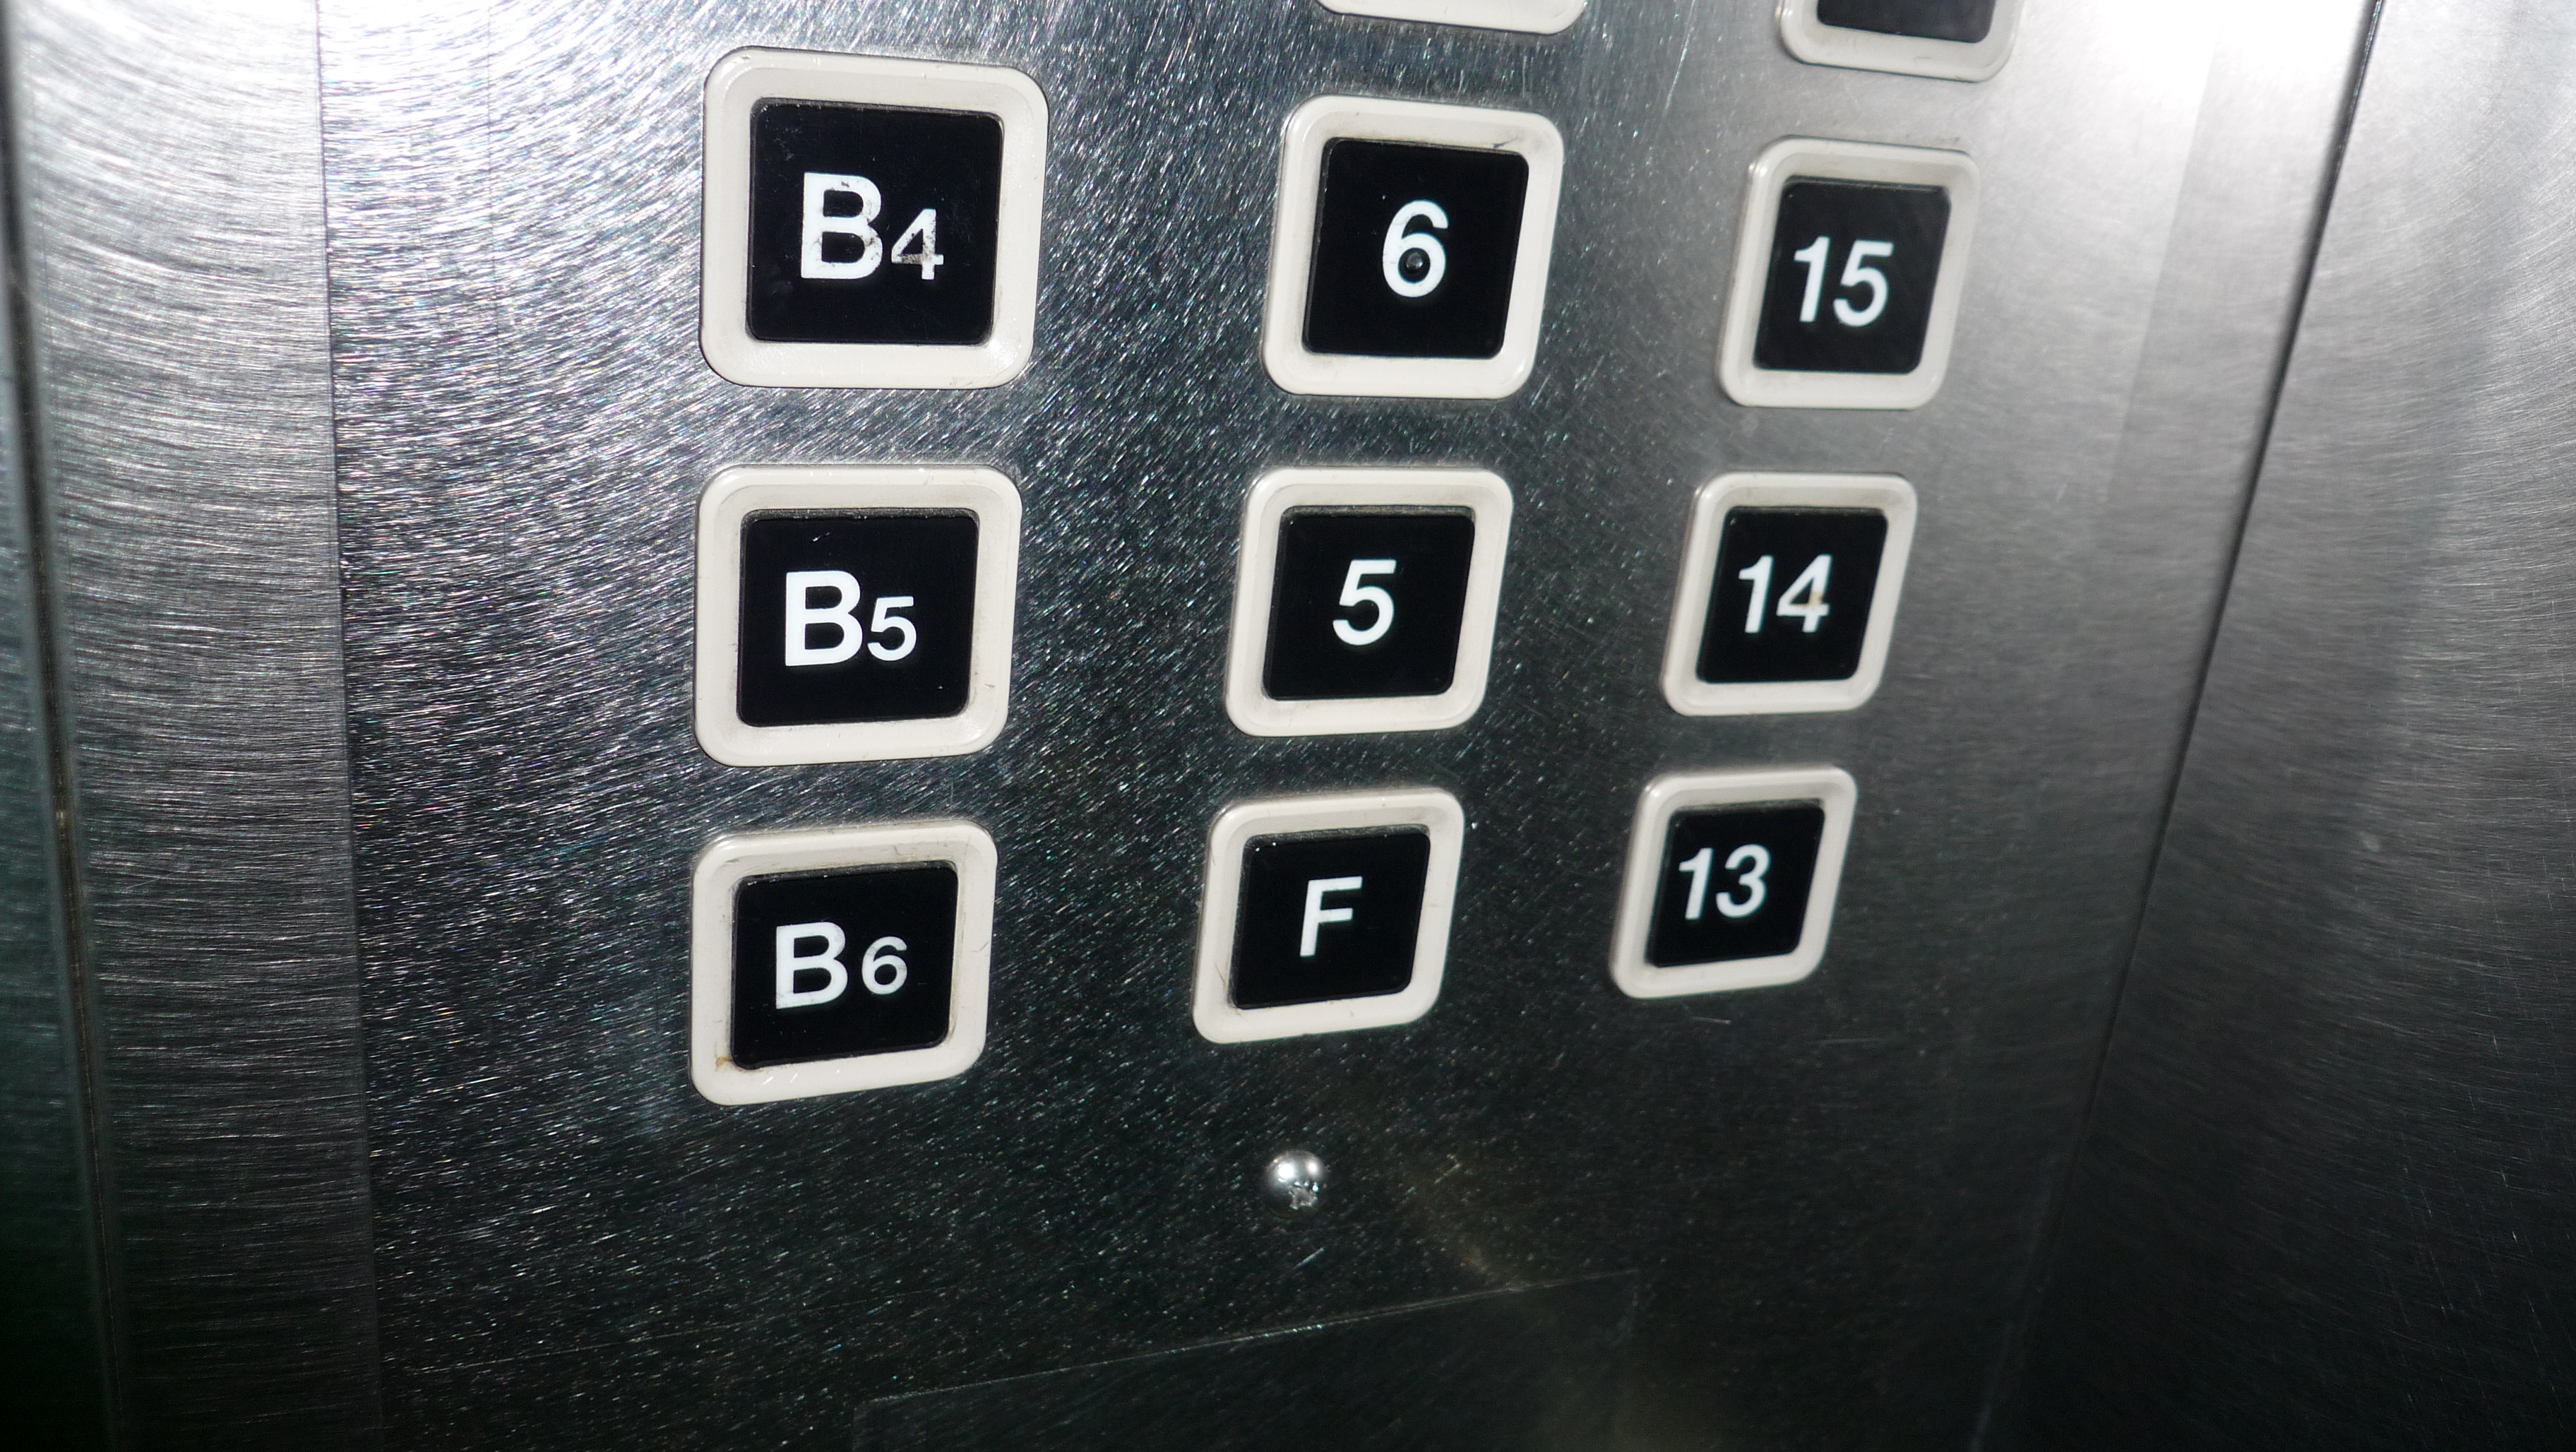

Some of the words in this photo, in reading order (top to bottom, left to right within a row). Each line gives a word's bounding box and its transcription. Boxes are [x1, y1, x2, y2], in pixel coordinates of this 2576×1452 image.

[799, 172, 945, 281] B4
[1381, 199, 1449, 298] 6
[1793, 236, 1895, 328] 15
[784, 569, 918, 667] B5
[1332, 558, 1397, 647] 5
[1738, 554, 1832, 634] 14
[1299, 875, 1364, 958] F
[1678, 843, 1771, 920] 13
[775, 921, 908, 1010] B6
